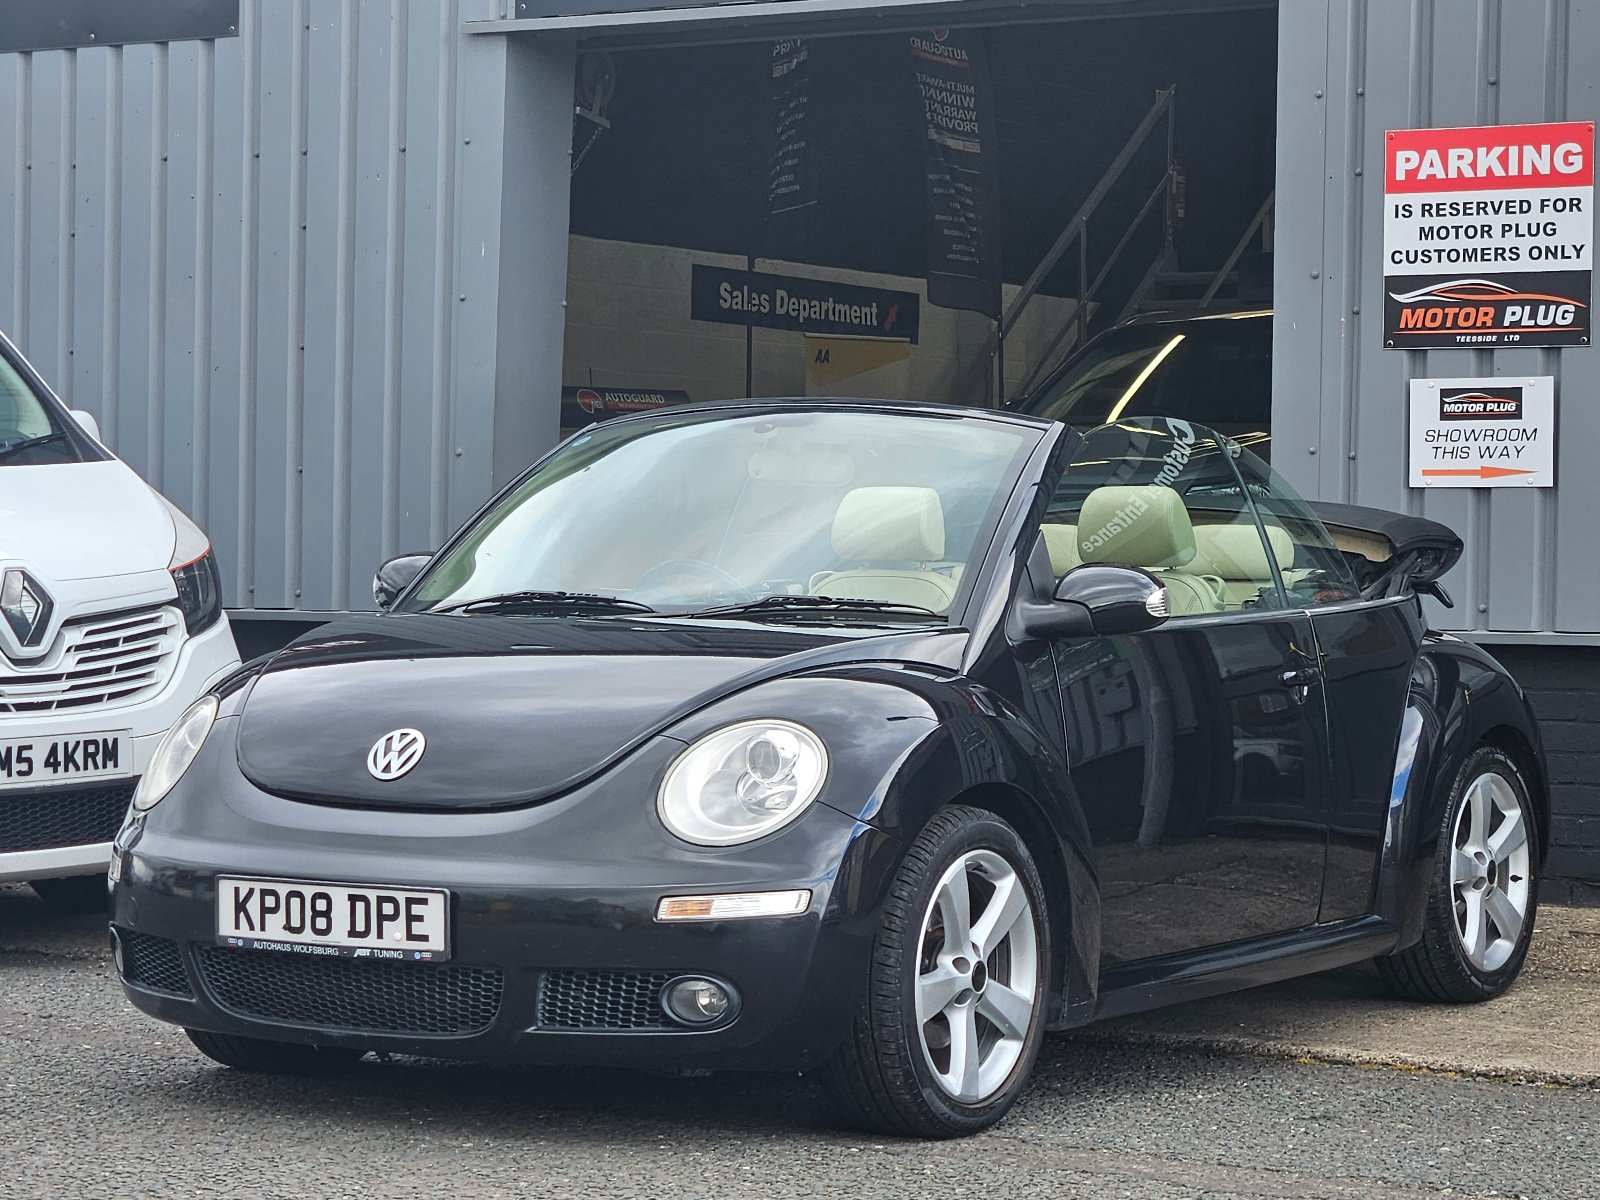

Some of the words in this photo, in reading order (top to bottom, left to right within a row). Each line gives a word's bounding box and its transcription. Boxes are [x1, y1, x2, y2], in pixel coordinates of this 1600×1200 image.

[1395, 143, 1583, 181] PARKING
[1394, 203, 1413, 219] IS
[1421, 199, 1532, 218] RESERVED
[1540, 197, 1583, 214] FOR
[1419, 224, 1493, 241] MOTOR
[1501, 222, 1557, 239] PLUG
[1390, 246, 1521, 265] CUSTOMERS
[1528, 244, 1585, 261] ONLY
[719, 282, 770, 315] Sales
[776, 289, 878, 326] Department
[1400, 306, 1496, 329] MOTOR
[1503, 304, 1576, 327] PLUG
[1455, 335, 1498, 343] TEESSIDE
[1504, 334, 1520, 342] LTD
[814, 348, 830, 364] AA
[605, 392, 665, 405] AUTOGUARD
[1443, 402, 1485, 413] MOTOR
[1486, 402, 1516, 412] PLUG
[1424, 428, 1538, 443] SHOWROOM
[1432, 446, 1471, 460] THIS
[1478, 445, 1526, 459] WAY
[0, 744, 34, 778] M5
[44, 737, 119, 774] 4KRM
[233, 886, 333, 937] KP08
[347, 893, 430, 943] DPE
[253, 941, 291, 952] AUTOHAUS
[292, 944, 339, 956] WOLFSBURG
[373, 949, 403, 959] TUNING
